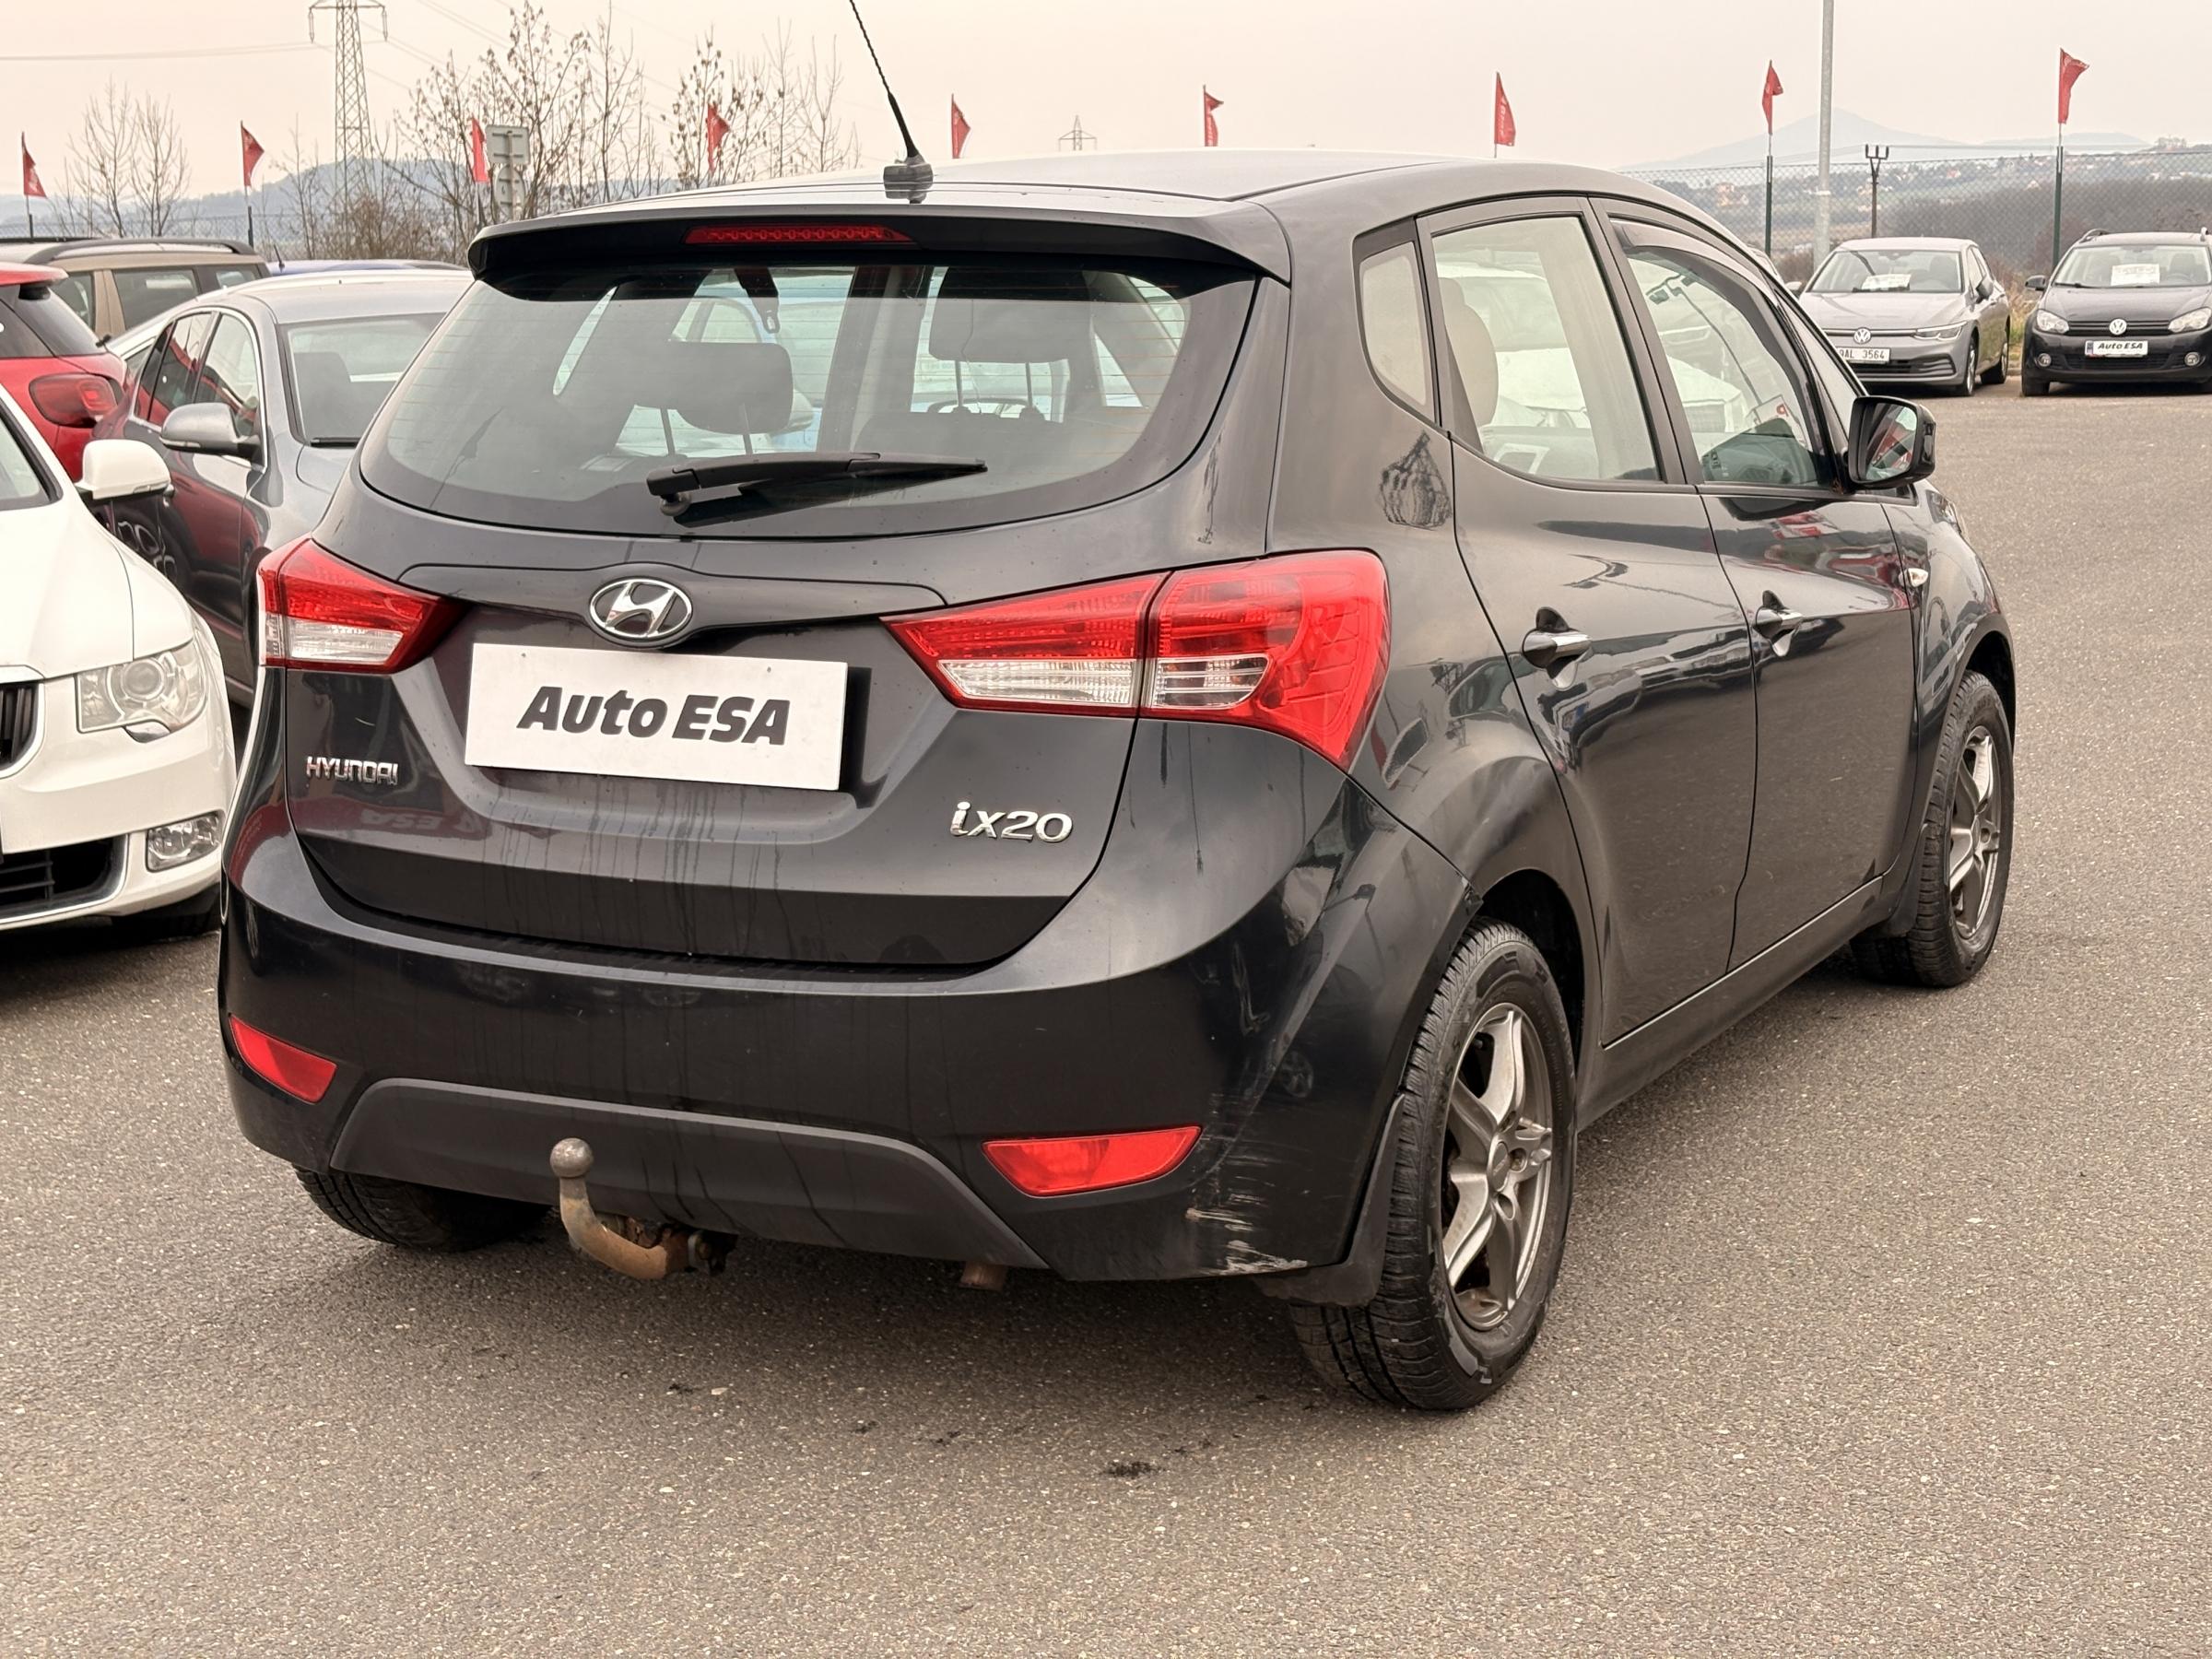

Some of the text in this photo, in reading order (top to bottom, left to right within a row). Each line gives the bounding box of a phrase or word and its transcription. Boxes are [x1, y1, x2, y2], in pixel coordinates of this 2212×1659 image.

[1862, 349, 1885, 359] 3564
[516, 686, 791, 746] Auto ESA
[306, 756, 398, 786] HYUNDAI
[950, 801, 1073, 842] ix20
